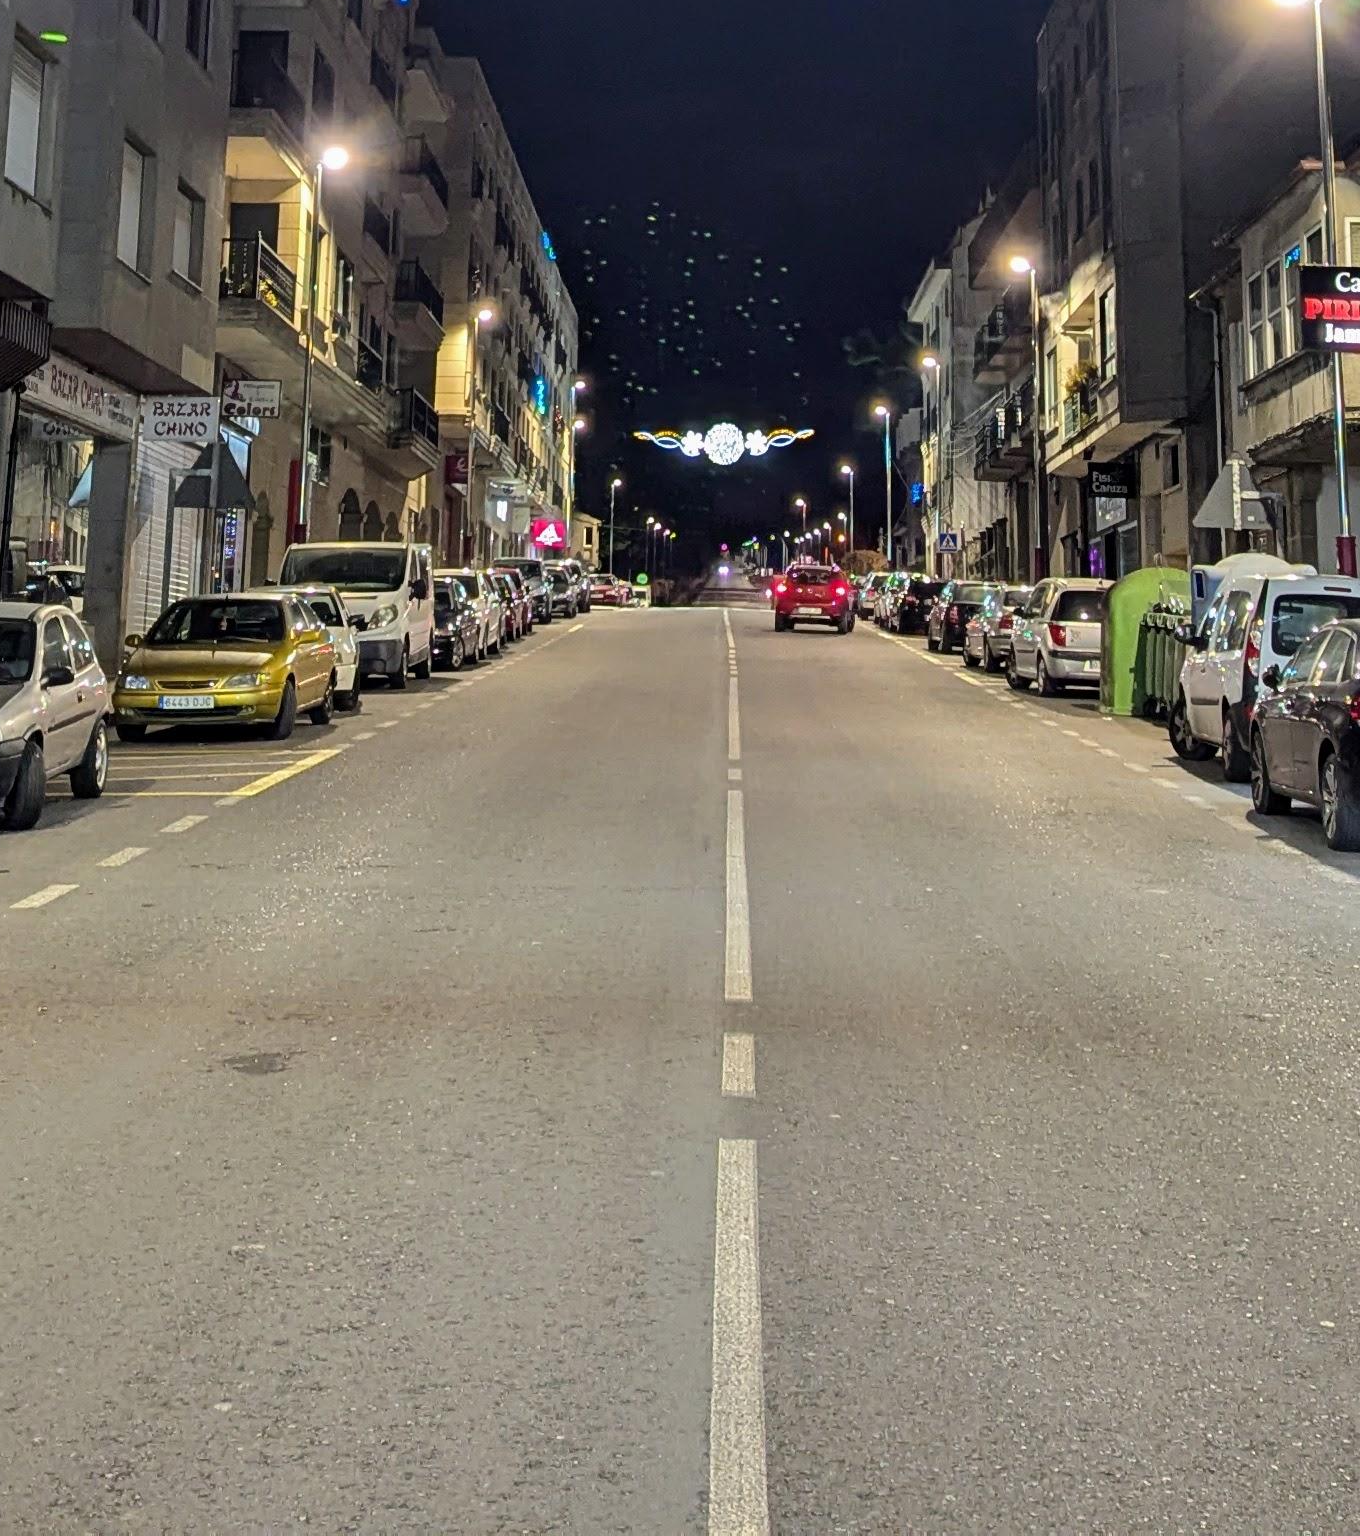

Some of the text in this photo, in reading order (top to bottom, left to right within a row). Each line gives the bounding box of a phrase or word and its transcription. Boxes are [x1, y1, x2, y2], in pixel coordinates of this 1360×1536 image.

[51, 364, 79, 405] BAZAR
[153, 401, 211, 417] BAZAR
[224, 402, 276, 416] Colors
[154, 421, 208, 437] CHINO
